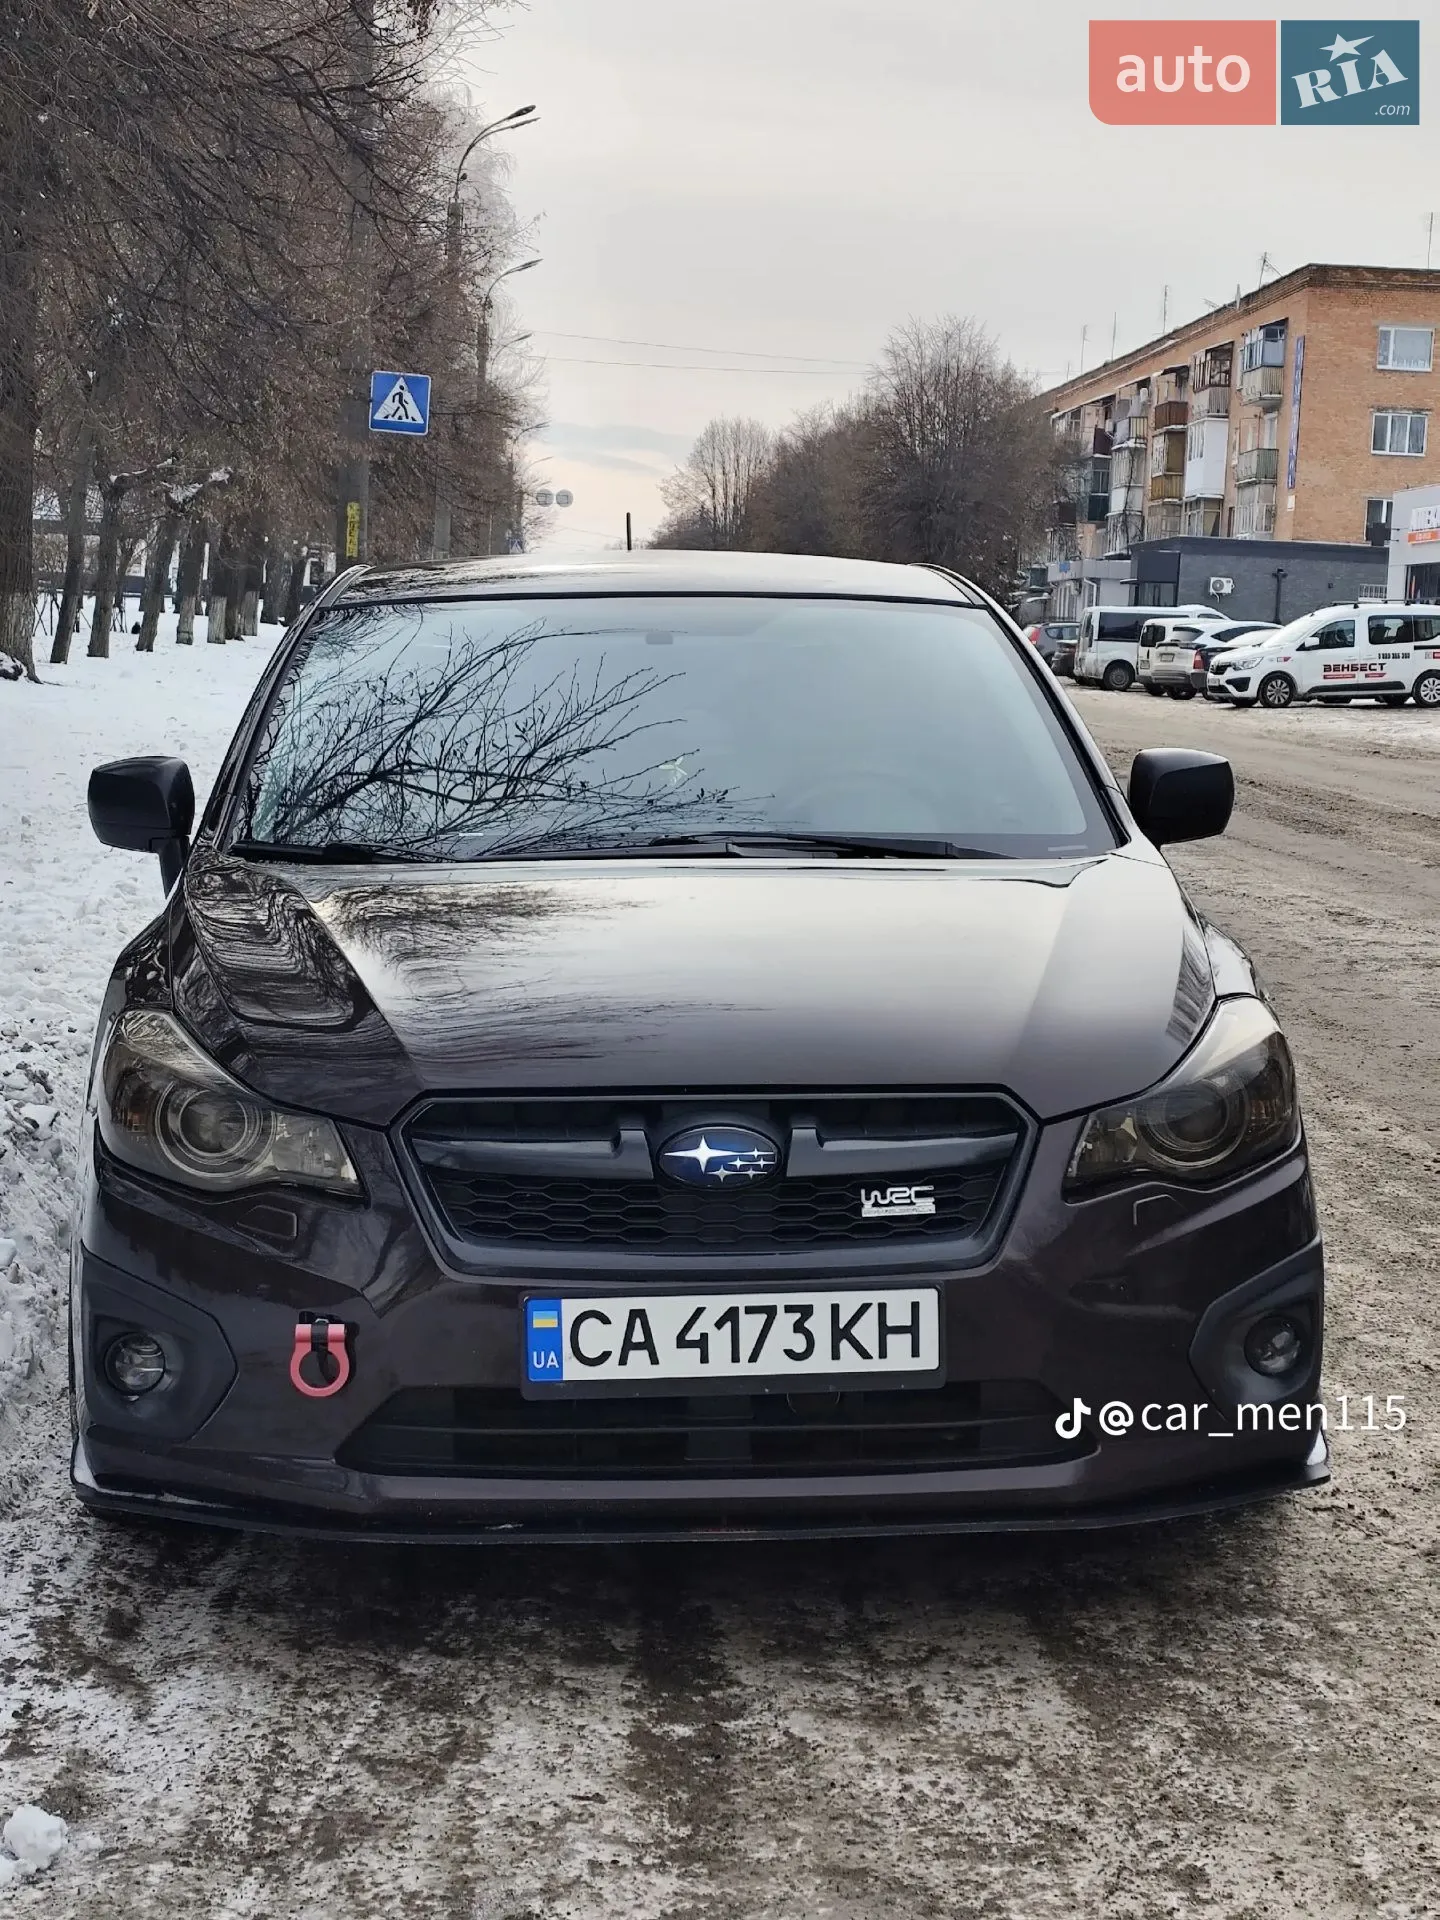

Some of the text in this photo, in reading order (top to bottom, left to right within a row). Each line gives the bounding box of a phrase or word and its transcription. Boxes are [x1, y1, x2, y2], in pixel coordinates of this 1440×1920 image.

[1323, 663, 1386, 672] ВЕНБЕСТ
[861, 1185, 934, 1204] WRC
[569, 1302, 921, 1367] CA 4173 KH
[532, 1351, 560, 1369] UA
